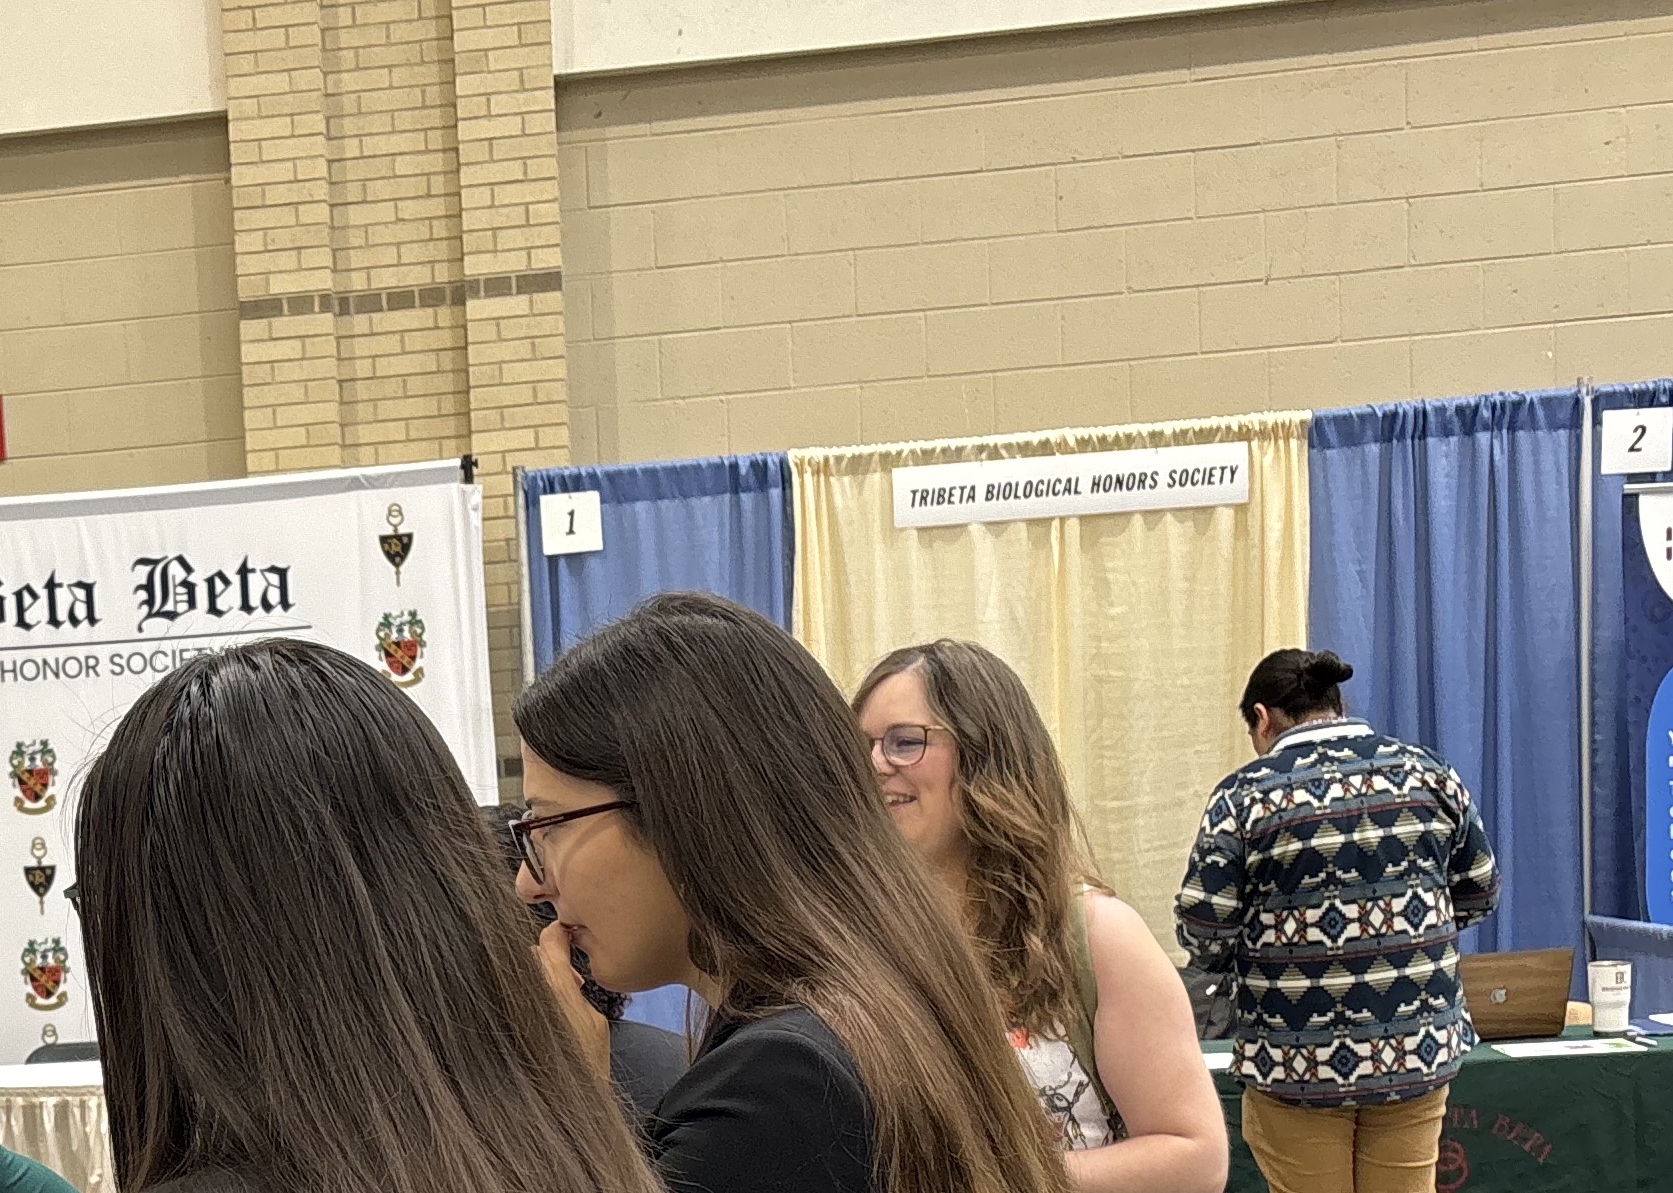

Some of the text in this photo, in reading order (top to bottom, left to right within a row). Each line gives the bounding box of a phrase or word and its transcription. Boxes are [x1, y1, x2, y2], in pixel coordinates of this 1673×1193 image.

[1627, 424, 1647, 453] 2
[910, 465, 1239, 509] TRIBETA BIOLOGICAL HONORS SOCIETY
[565, 509, 576, 536] 1
[132, 554, 294, 634] Beta
[0, 654, 101, 683] HONOR
[109, 647, 226, 677] SOCI
